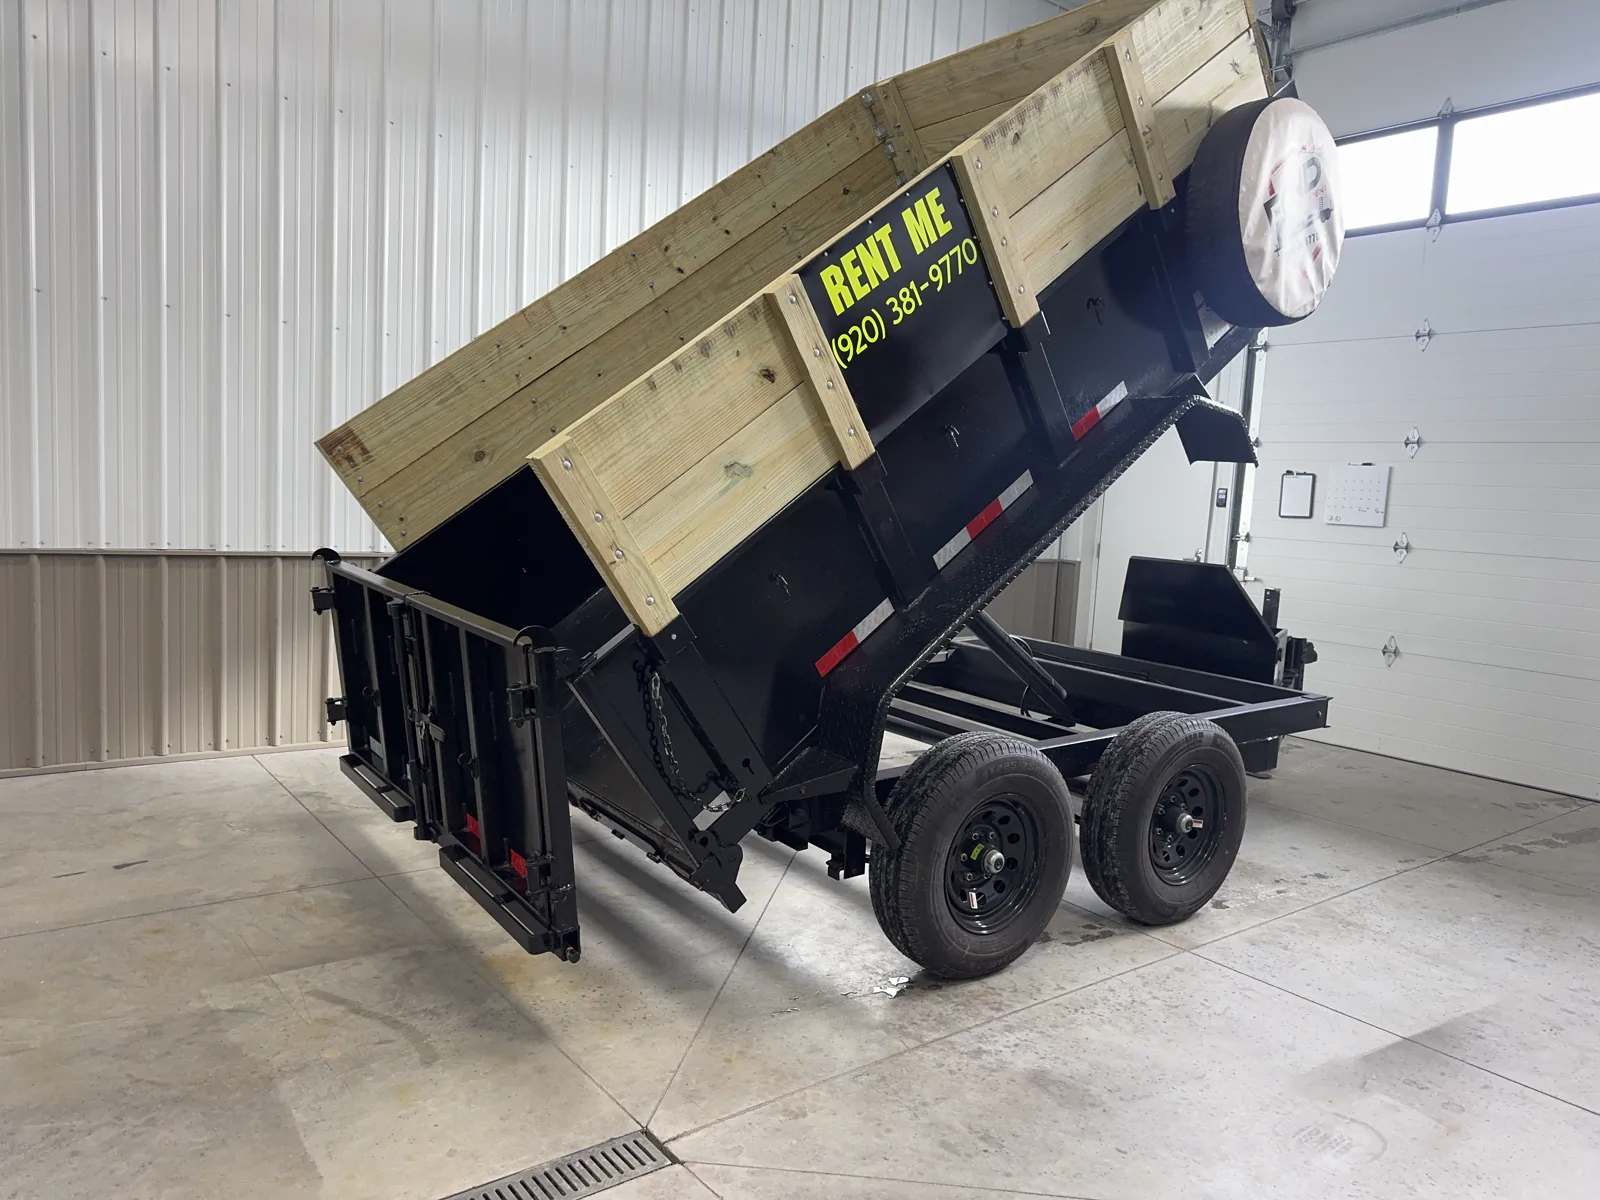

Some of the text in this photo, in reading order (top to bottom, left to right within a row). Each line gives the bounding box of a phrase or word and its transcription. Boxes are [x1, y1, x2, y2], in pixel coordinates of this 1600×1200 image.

[820, 187, 953, 316] RENT ME
[831, 238, 978, 369] (920) 381-9770
